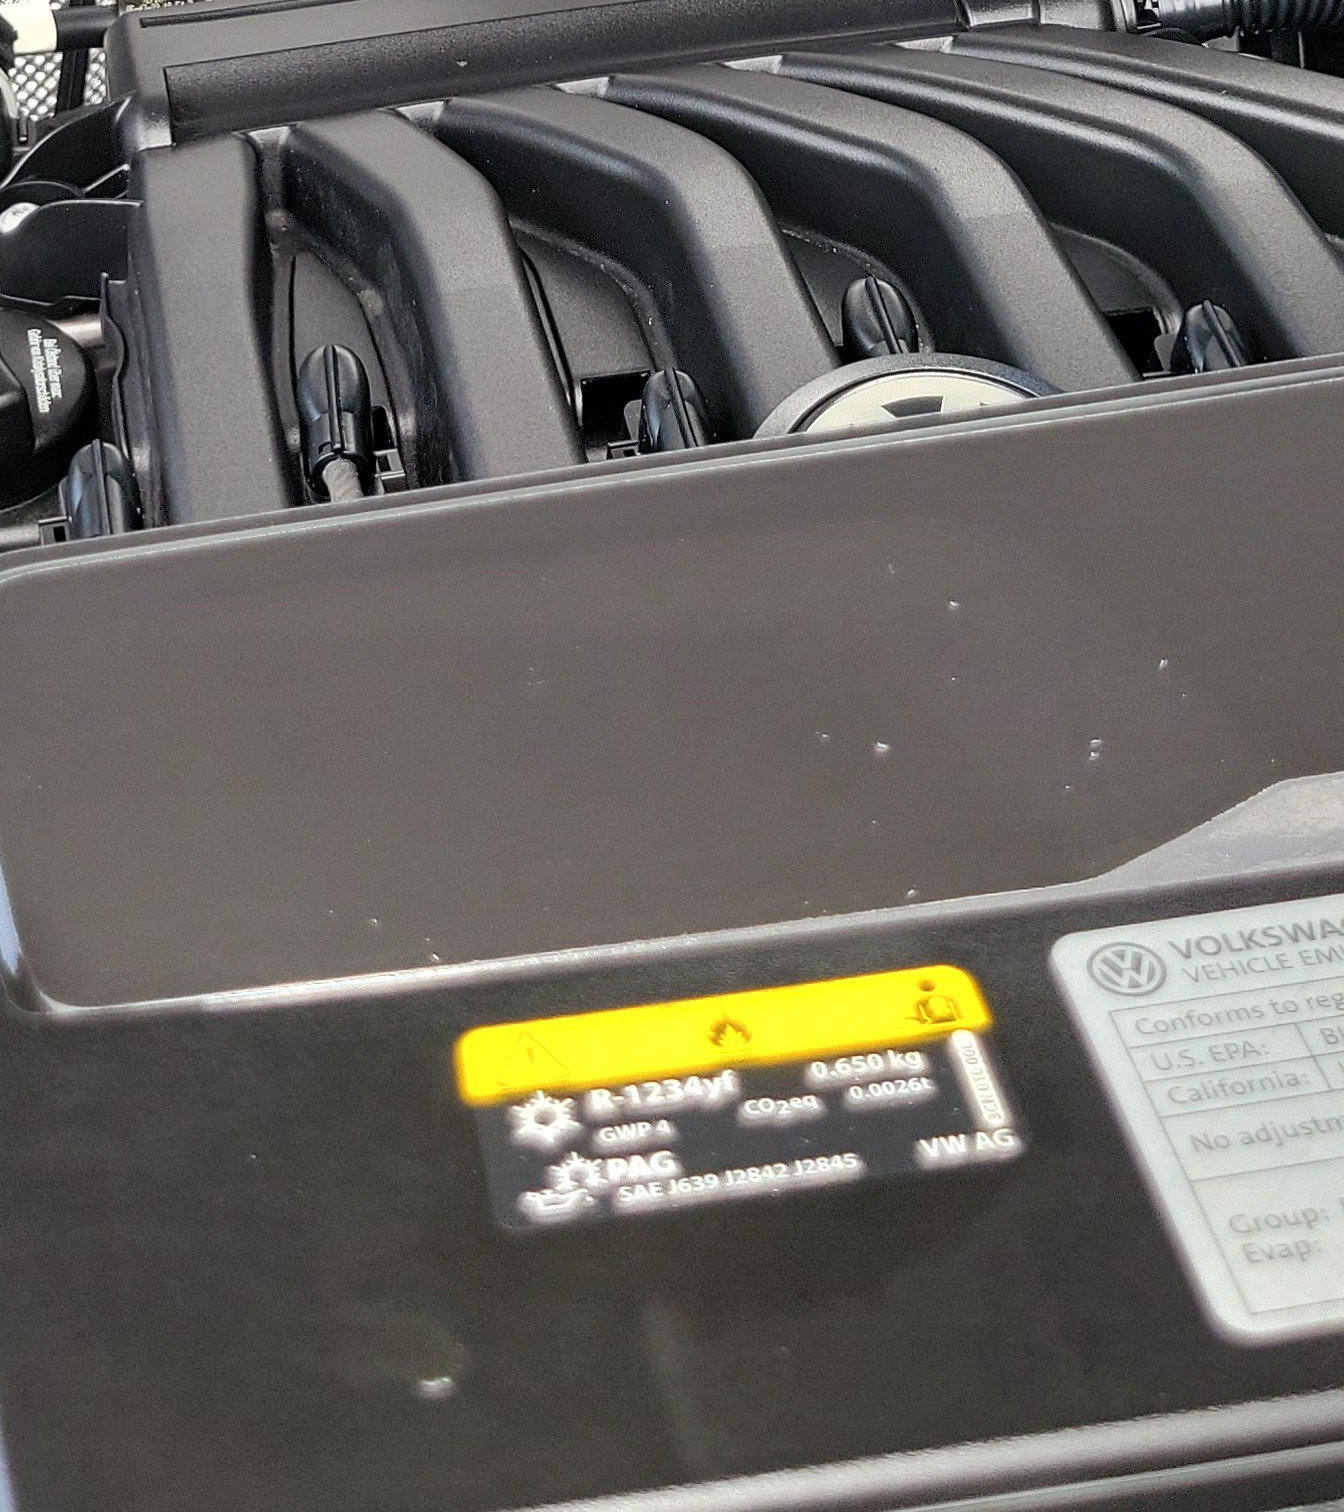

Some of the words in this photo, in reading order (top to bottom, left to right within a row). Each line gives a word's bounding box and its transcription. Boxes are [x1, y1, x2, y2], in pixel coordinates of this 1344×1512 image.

[1181, 951, 1295, 984] VEHICLE
[1135, 1002, 1265, 1036] Conforms
[1271, 998, 1299, 1016] to
[810, 1052, 884, 1080] 0.650
[886, 1049, 927, 1074] kg
[1149, 1048, 1205, 1072] U.S.
[1209, 1039, 1271, 1063] EPA:
[590, 1068, 737, 1111] R-1234yf
[848, 1076, 934, 1101] 0.0026t
[1167, 1068, 1311, 1106] California:
[598, 1121, 652, 1144] GWP
[655, 1119, 672, 1135] 4
[918, 1133, 968, 1159] VW
[974, 1127, 1016, 1151] AG
[1189, 1131, 1231, 1155] No
[606, 1149, 677, 1180] PAG
[619, 1182, 665, 1204] SAE
[668, 1173, 720, 1196] J639
[722, 1161, 790, 1187] J2842
[794, 1151, 859, 1177] J2845
[1227, 1204, 1333, 1237] Group:
[1242, 1238, 1324, 1268] Evap:
